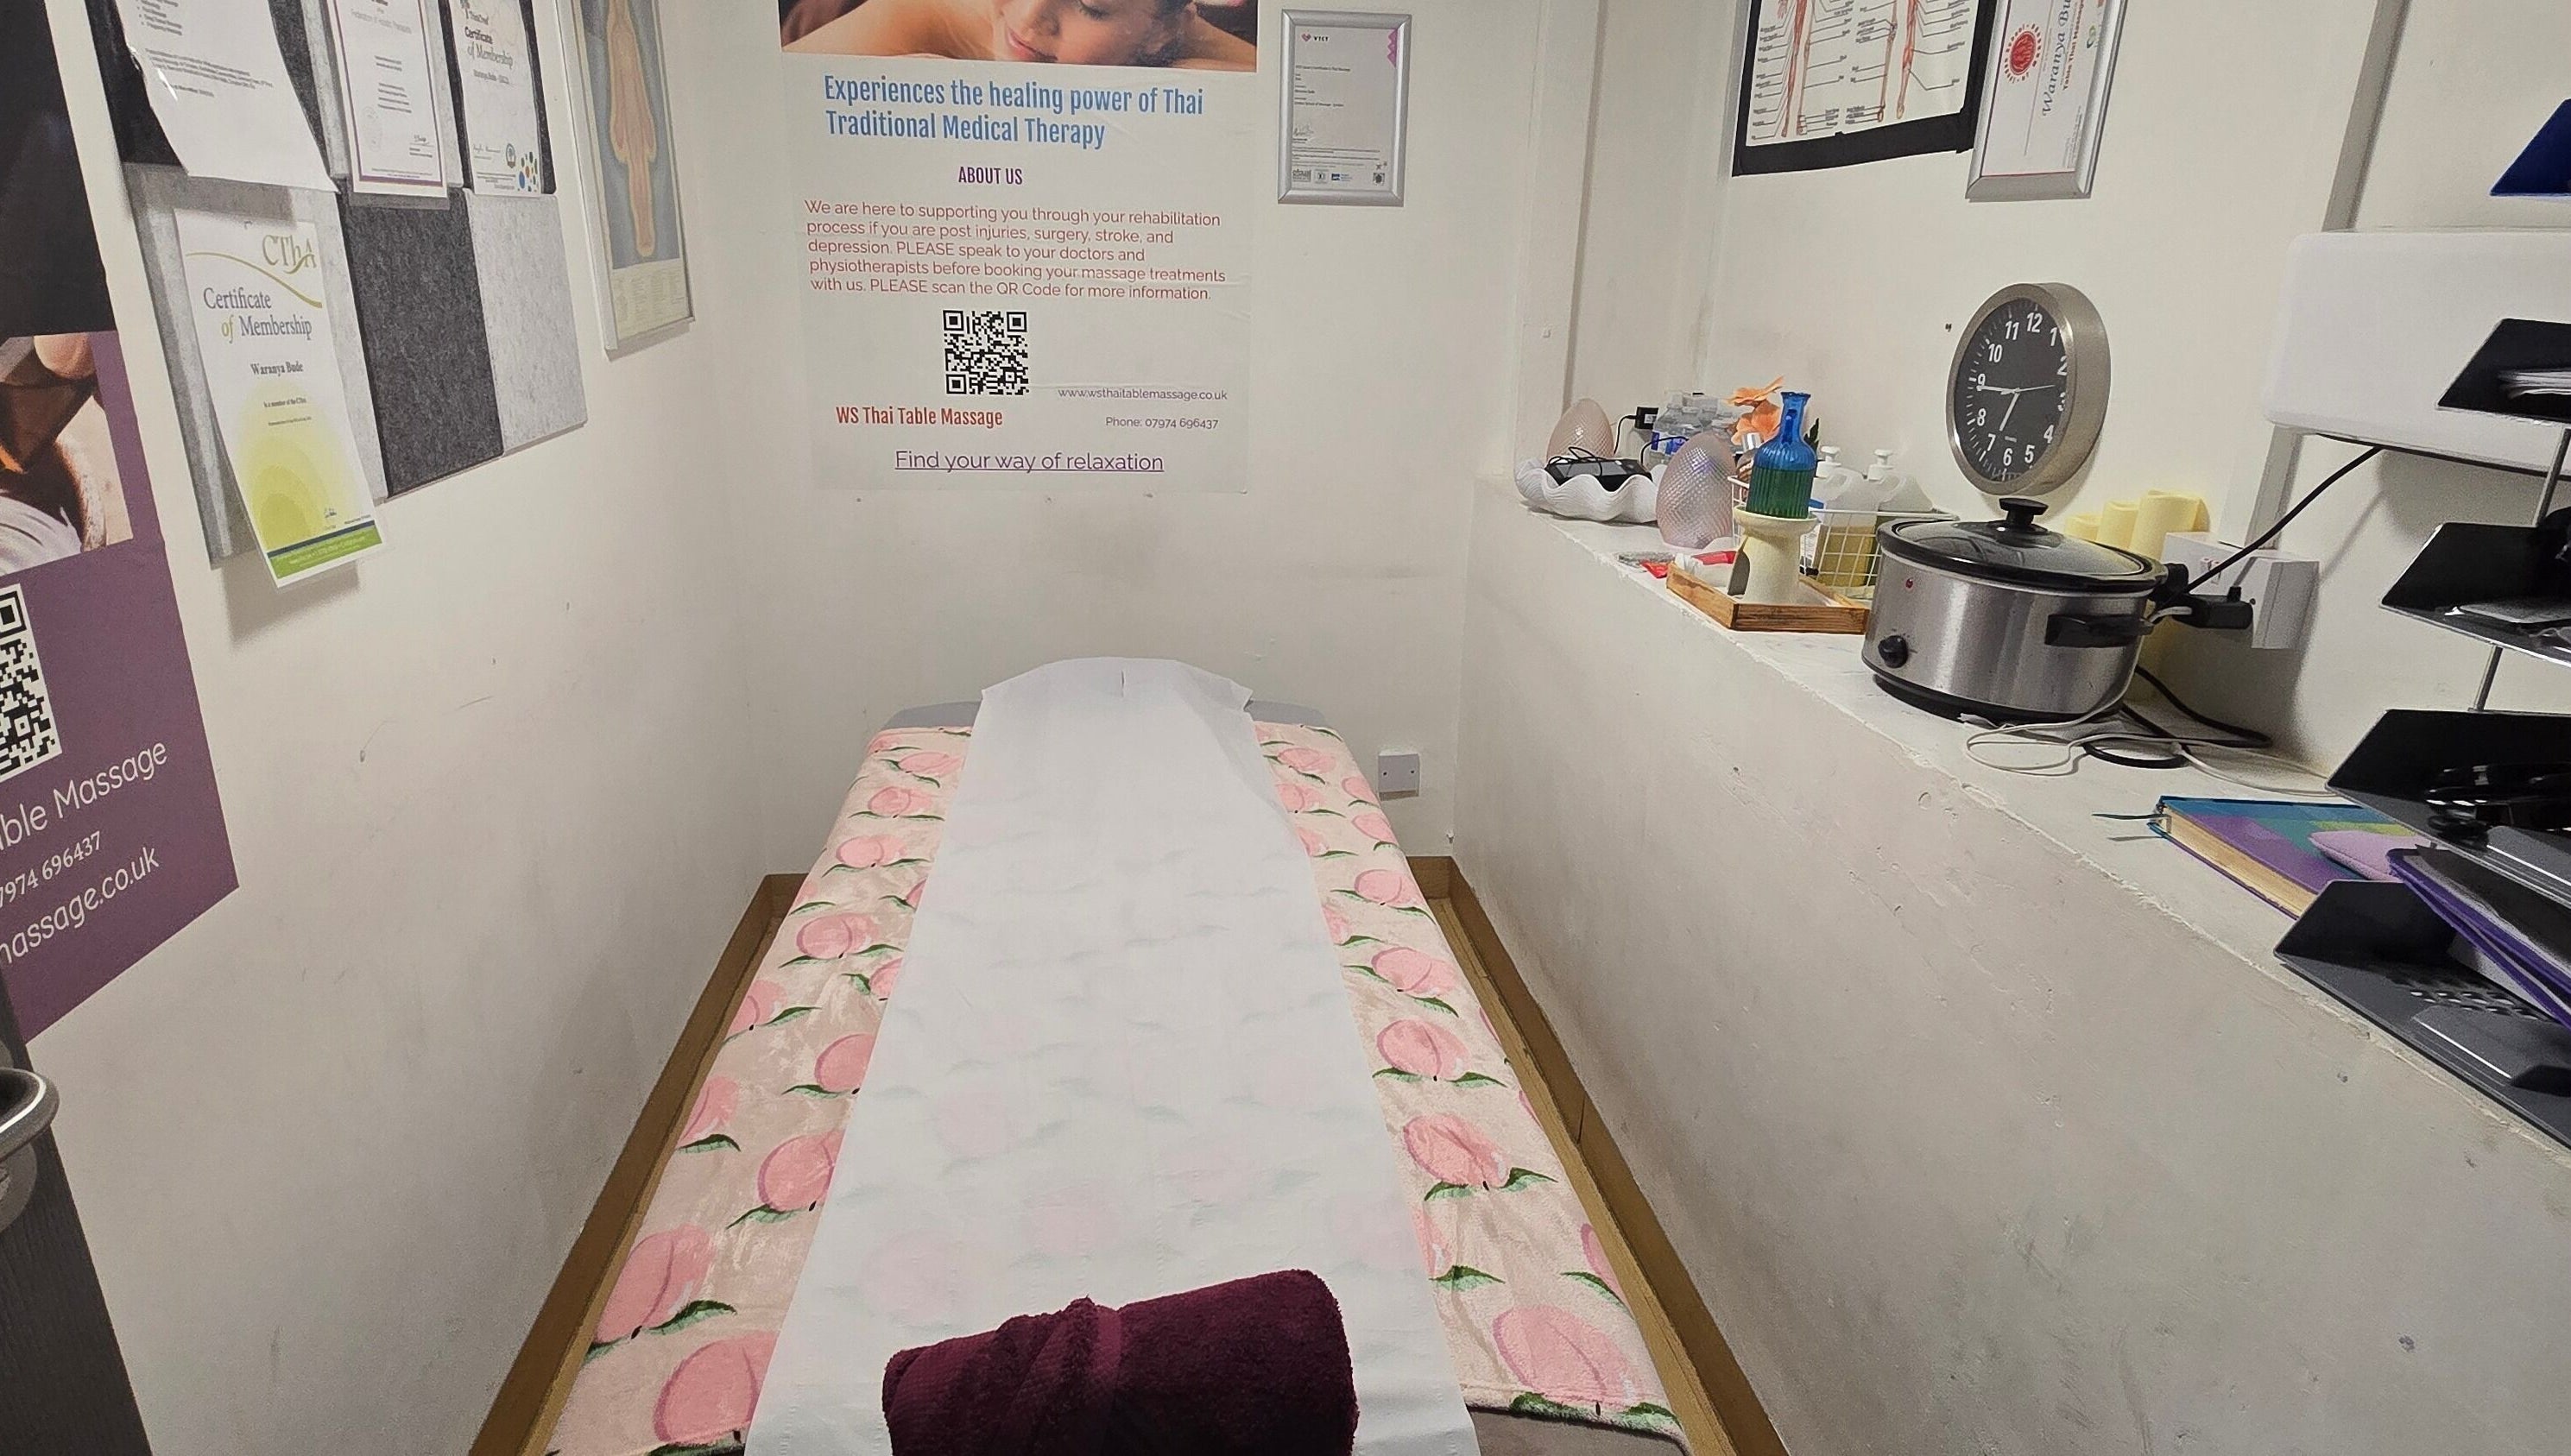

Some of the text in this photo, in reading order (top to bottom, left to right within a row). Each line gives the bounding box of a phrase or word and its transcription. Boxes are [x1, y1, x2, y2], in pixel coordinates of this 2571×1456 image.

[824, 76, 1203, 115] Experiences the healing power of Thai
[826, 110, 1105, 150] Traditional Medical Therapy
[958, 166, 1022, 185] ABOUT US
[805, 200, 1220, 226] We are here to supporting you through your rehabilitation
[807, 221, 1173, 244] process if you are post injuries, surgery, stroke, and
[808, 239, 1144, 261] depression. PLEASE speak to your doctors and
[810, 258, 1226, 282] physiotherapists before booking your massage treatments
[204, 287, 271, 309] Certificate
[811, 278, 1211, 299] with us. PLEASE scan the QR Code for more information.
[222, 314, 312, 344] of Membership
[2005, 321, 2019, 340] 11
[2026, 312, 2044, 332] 12
[2050, 327, 2057, 346] 1
[1988, 344, 2002, 362] 10
[250, 361, 303, 376] Waranya Bude
[2057, 356, 2068, 375] 2
[1977, 374, 1986, 387] 9
[837, 407, 1003, 429] WS Thai Table Massage
[1105, 416, 1218, 429] Phone: 07974 696437
[1977, 407, 1987, 425] 8
[1987, 434, 1996, 451] 7
[2044, 425, 2054, 443] 4
[895, 451, 1164, 473] Find your way of relaxation
[2004, 447, 2012, 466] 6
[2025, 445, 2035, 463] 5
[0, 742, 167, 850] ble Massage
[41, 830, 100, 879] 696437
